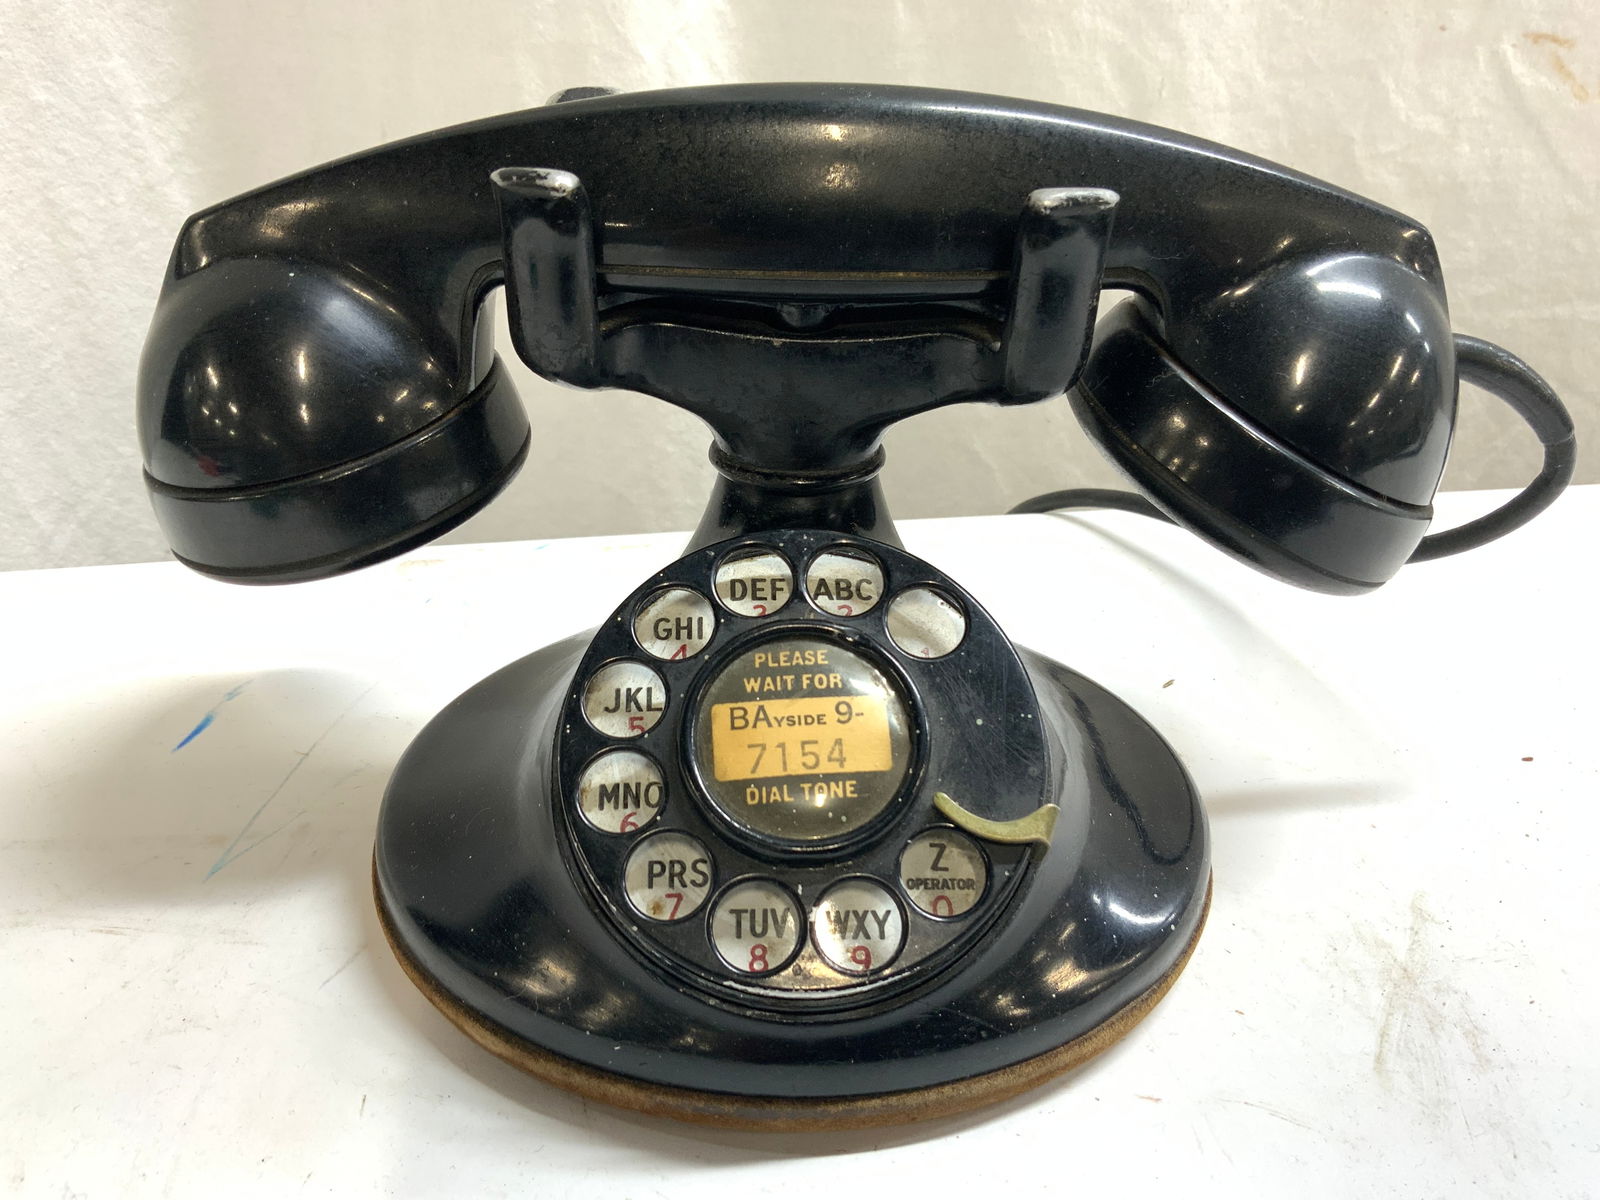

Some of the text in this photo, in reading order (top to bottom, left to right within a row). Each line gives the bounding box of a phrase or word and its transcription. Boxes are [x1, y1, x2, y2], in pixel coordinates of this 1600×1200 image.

[729, 578, 786, 602] DEF
[813, 578, 873, 601] ABC
[653, 616, 704, 641] GHI
[754, 650, 829, 668] PLEASE
[743, 673, 842, 693] WAIT FOR
[604, 687, 663, 714] JKL
[747, 738, 847, 775] 7154
[598, 781, 663, 811] MNO
[746, 780, 858, 805] DIAL TONE
[929, 842, 950, 872] Z
[647, 858, 710, 890] PRS
[906, 878, 976, 890] OPERATOR
[664, 892, 684, 921] 7
[729, 907, 790, 939] TUV
[749, 943, 769, 973] 8
[850, 945, 872, 974] 9
